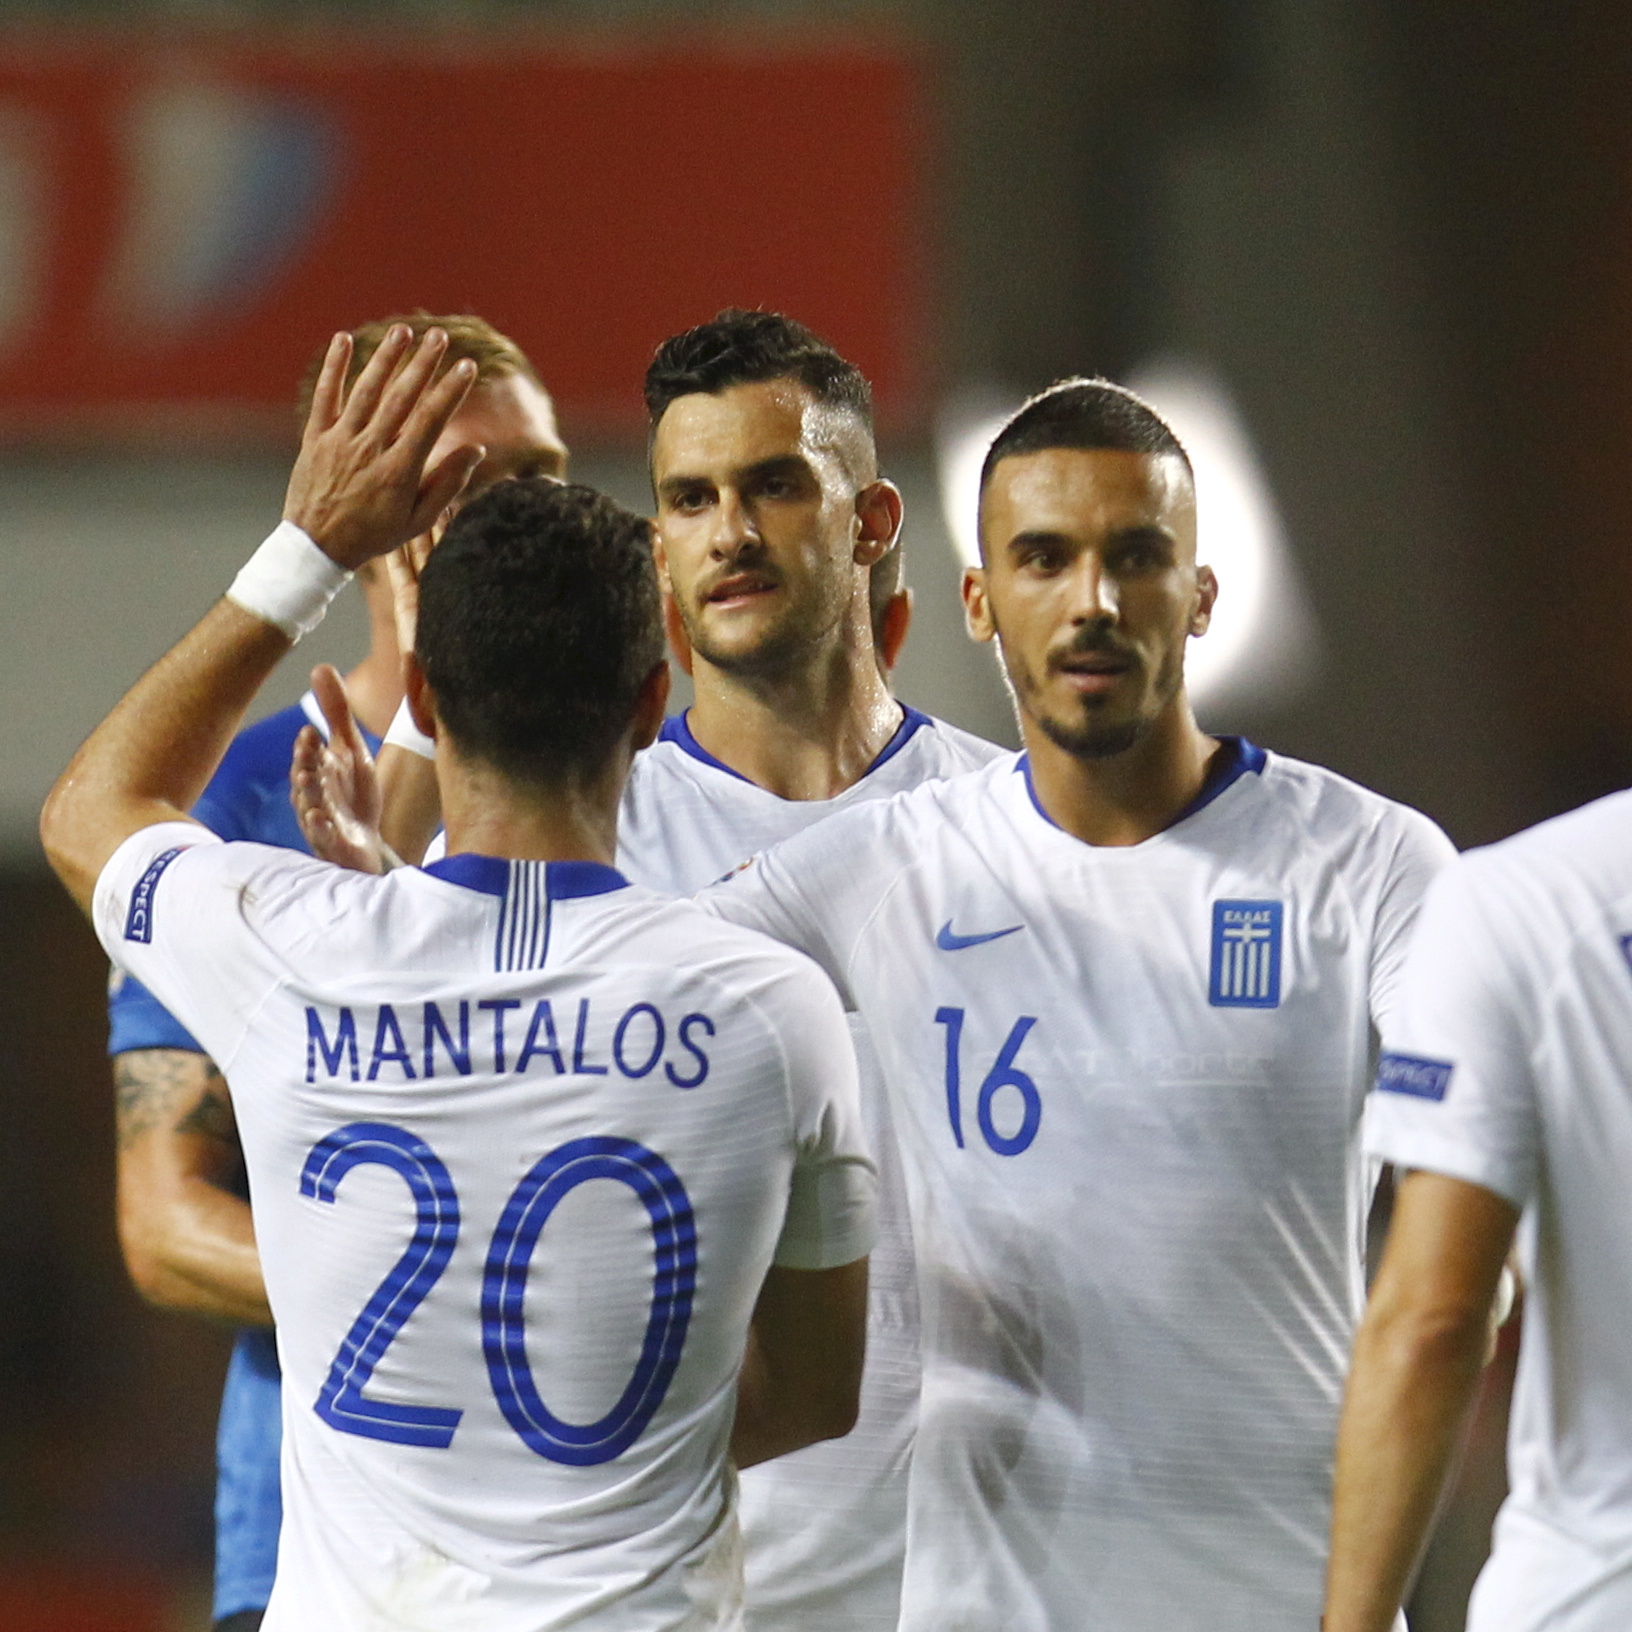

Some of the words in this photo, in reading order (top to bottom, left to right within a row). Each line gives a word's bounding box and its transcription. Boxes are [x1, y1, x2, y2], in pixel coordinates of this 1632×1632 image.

[132, 849, 177, 941] RESPECT
[306, 1001, 714, 1089] MANTALOS
[934, 1007, 1042, 1157] 16
[300, 1122, 697, 1466] 20
